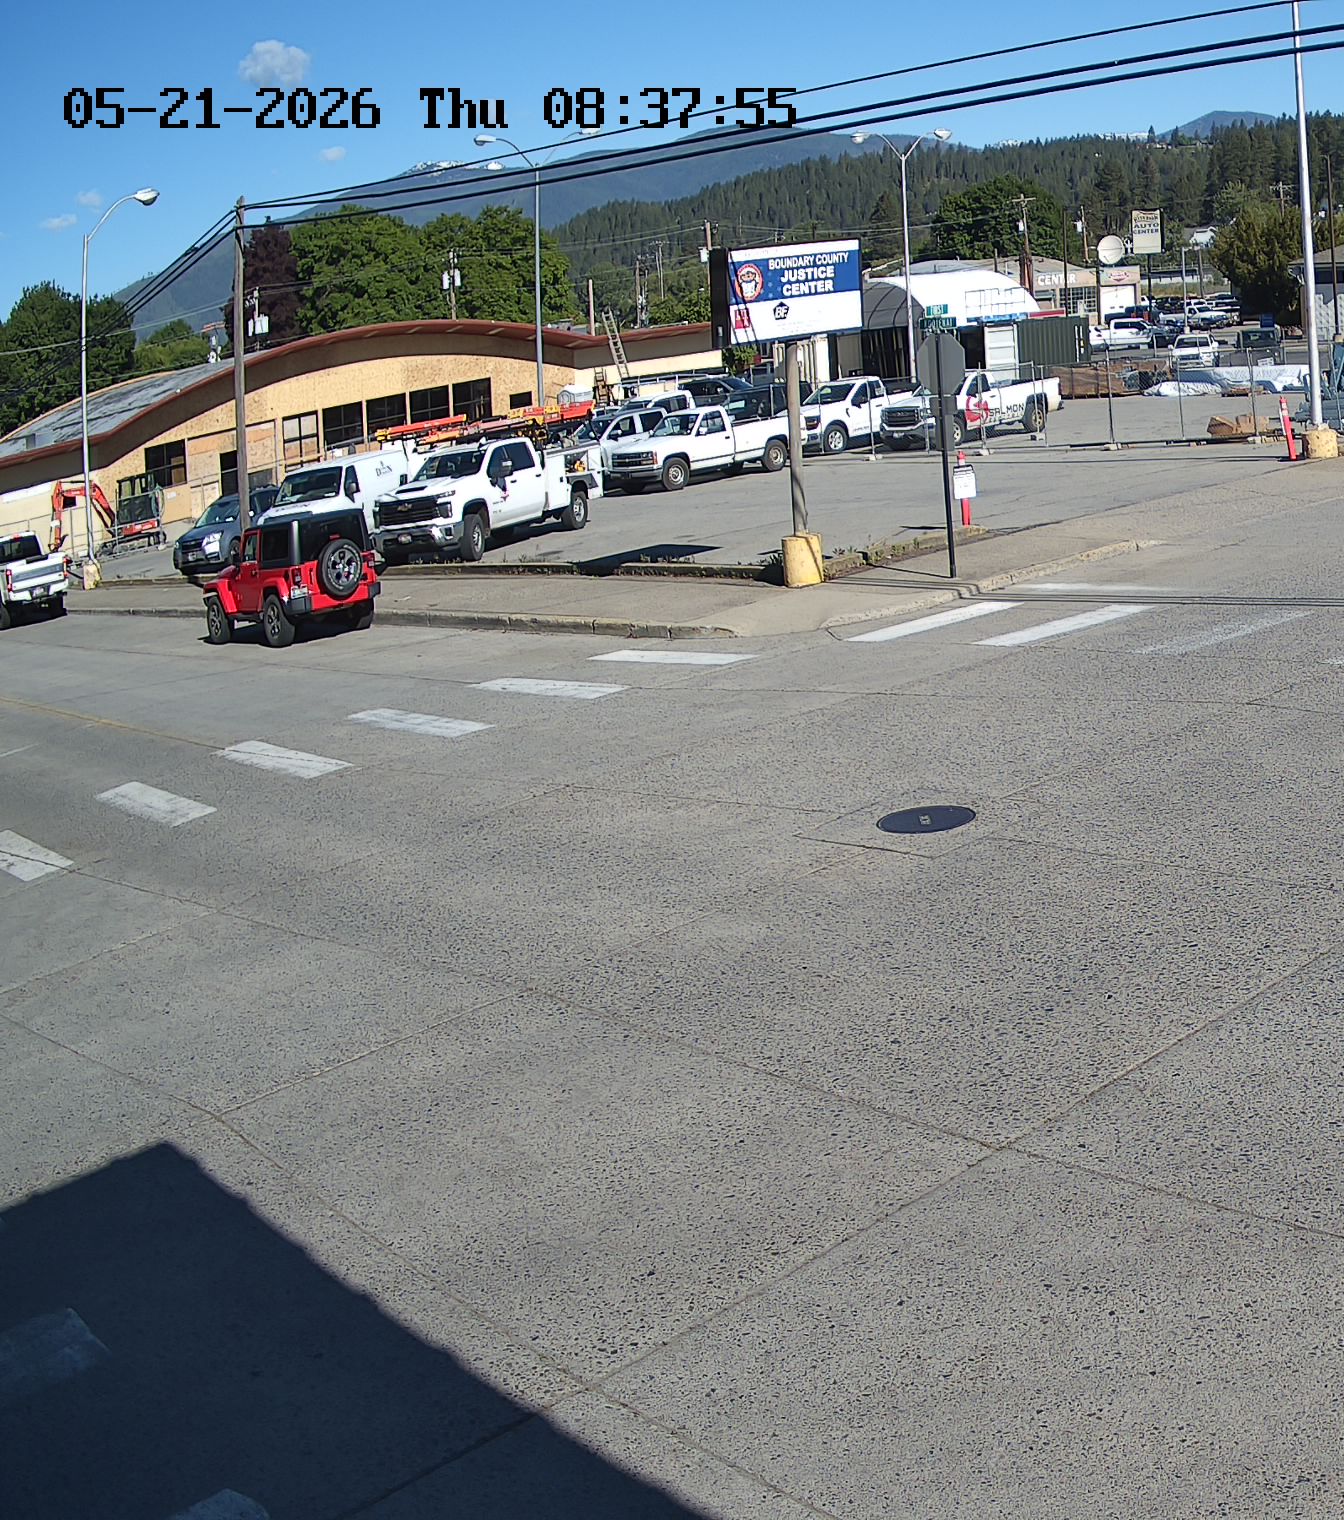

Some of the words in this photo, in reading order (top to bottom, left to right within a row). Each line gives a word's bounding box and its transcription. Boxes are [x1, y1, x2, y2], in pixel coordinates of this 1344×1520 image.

[768, 254, 815, 270] BOUNDARY
[815, 252, 849, 265] COUNTY
[780, 265, 835, 283] JUSTICE
[782, 279, 834, 296] CENTER
[988, 402, 1025, 418] SALMON
